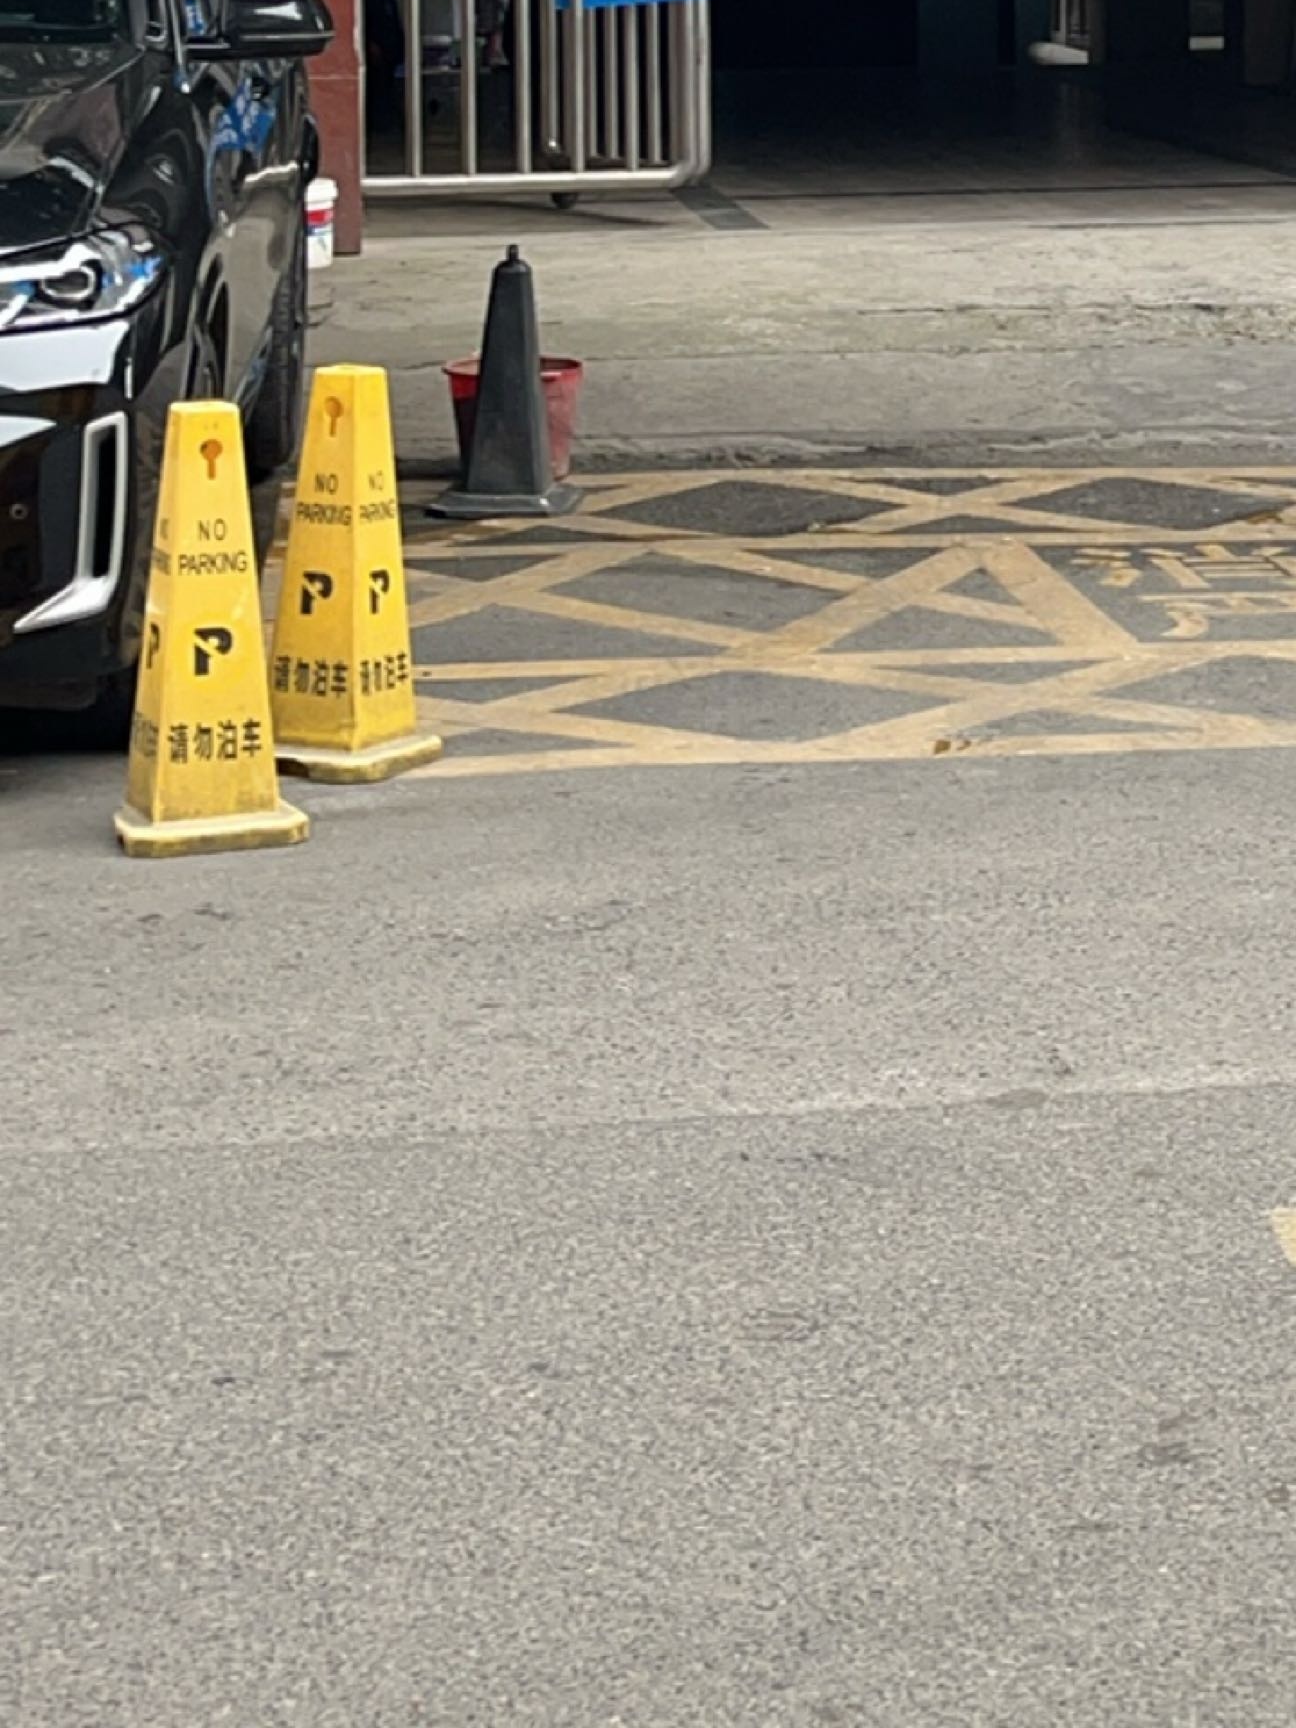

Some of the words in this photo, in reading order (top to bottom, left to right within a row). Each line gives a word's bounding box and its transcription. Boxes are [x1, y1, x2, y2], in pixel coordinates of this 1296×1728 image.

[314, 473, 340, 495] NO
[296, 501, 352, 527] PARKING
[197, 518, 227, 542] NO
[177, 550, 249, 576] PARKING
[300, 569, 334, 615] P
[193, 626, 233, 677] P
[166, 718, 263, 764] 请勿泊车
